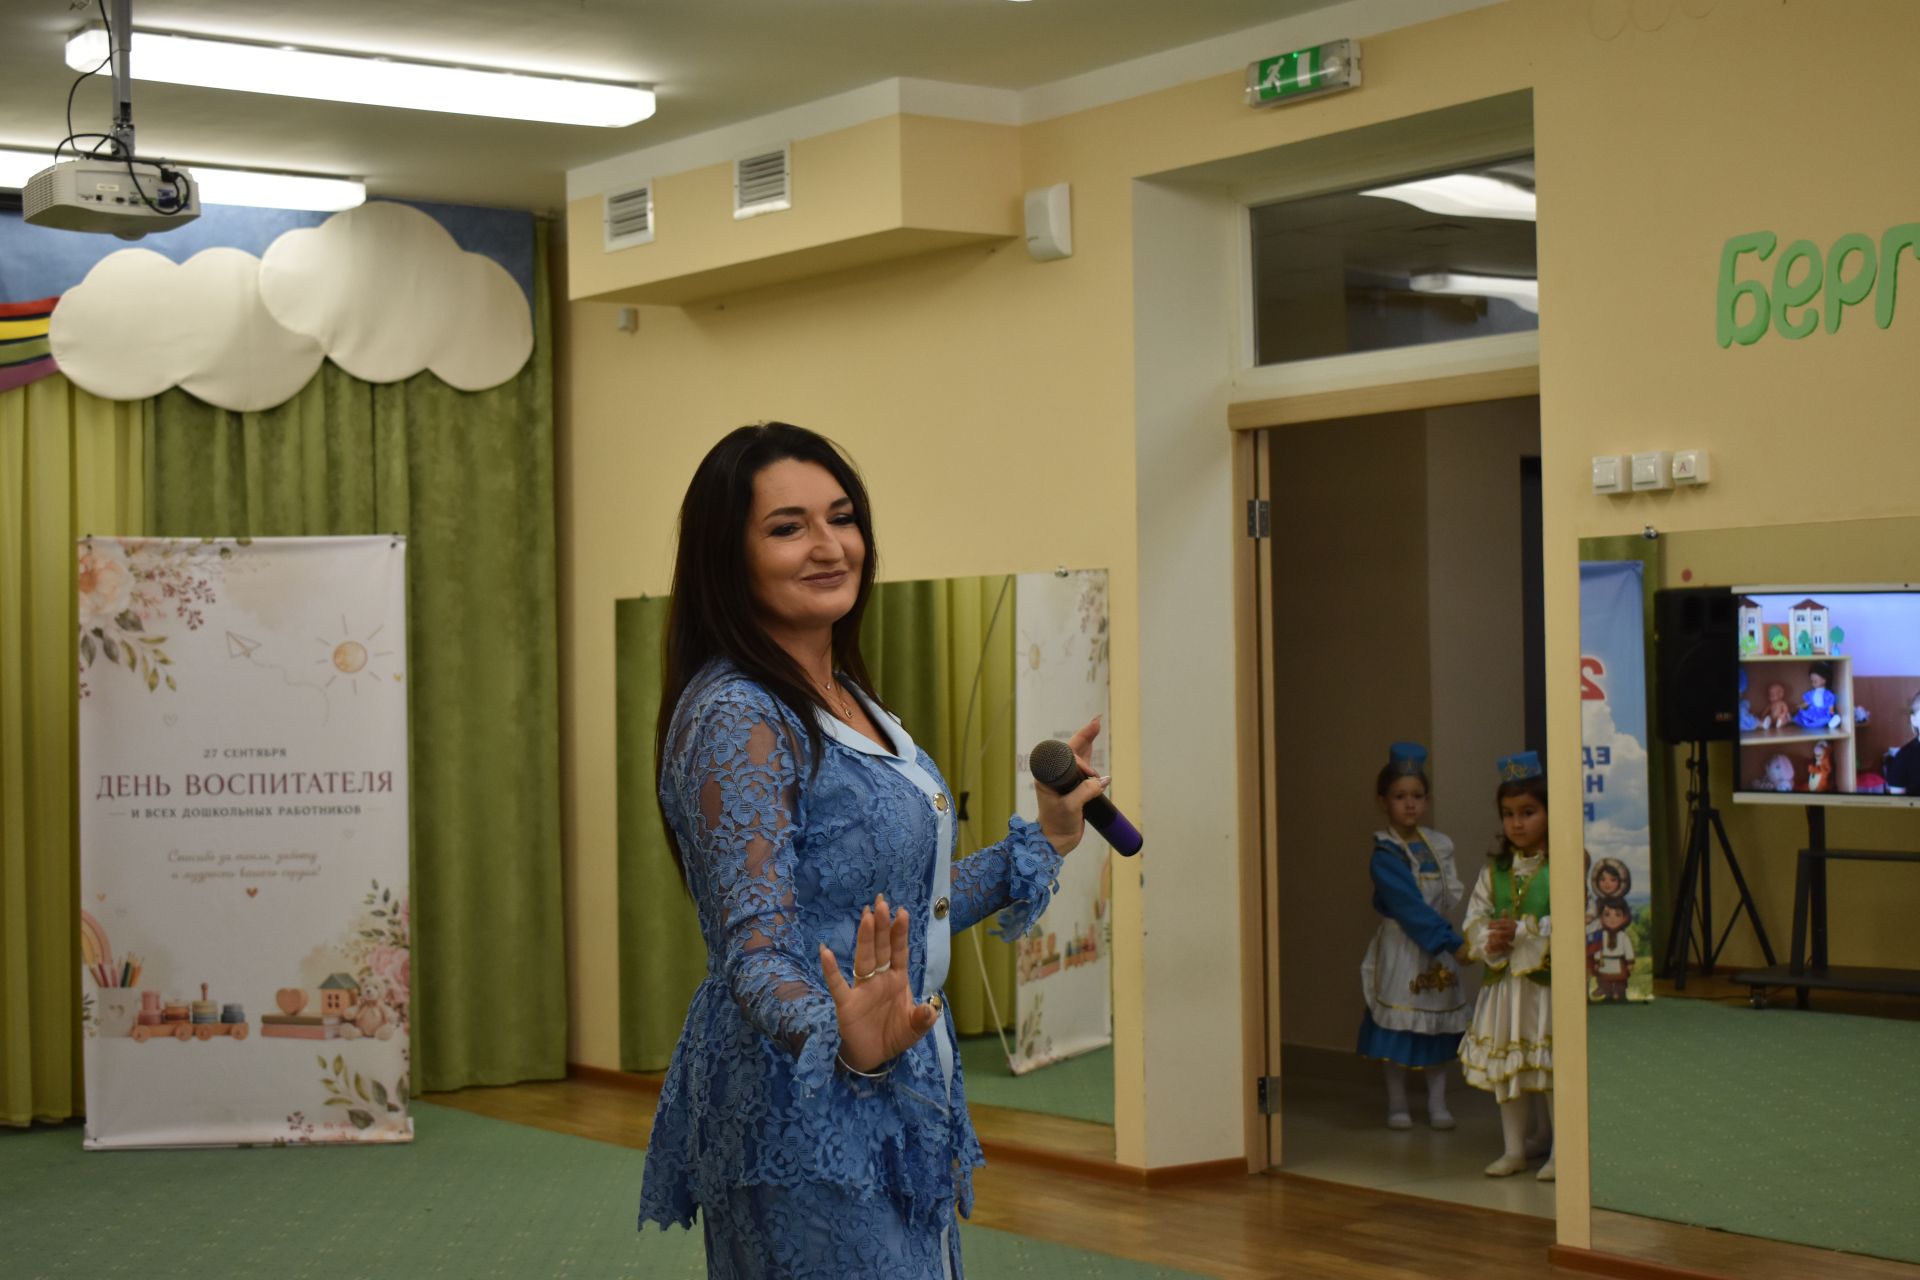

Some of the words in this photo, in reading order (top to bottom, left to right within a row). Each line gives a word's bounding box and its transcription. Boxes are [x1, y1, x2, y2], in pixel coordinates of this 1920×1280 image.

[203, 749, 217, 759] 27
[223, 748, 287, 759] СЕНТЯБРЯ
[96, 773, 172, 800] ДЕНЬ
[185, 770, 393, 796] ВОСПИТАТЕЛЯ
[131, 808, 140, 819] И
[145, 807, 176, 819] ВСЕХ
[181, 806, 273, 819] ДОШКОЛЬНЫХ
[279, 804, 362, 817] РАБОТНИКОВ
